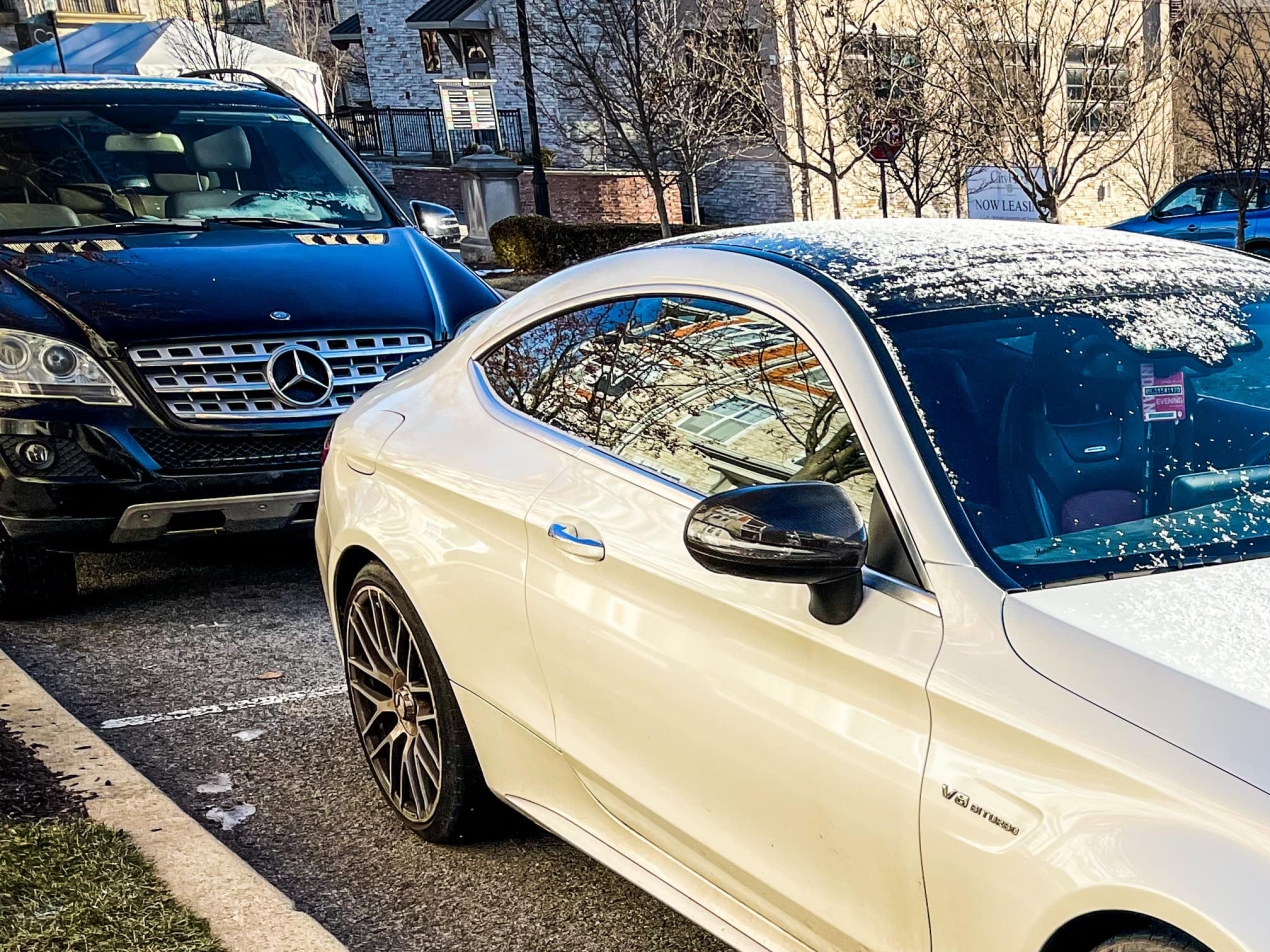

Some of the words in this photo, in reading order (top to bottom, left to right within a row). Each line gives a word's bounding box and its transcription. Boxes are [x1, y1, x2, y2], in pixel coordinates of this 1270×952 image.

[975, 199, 999, 211] NOW
[1002, 200, 1046, 213] LEASI
[1156, 397, 1183, 405] EVENING
[942, 783, 970, 808] V8
[970, 804, 1020, 836] BITURBO
